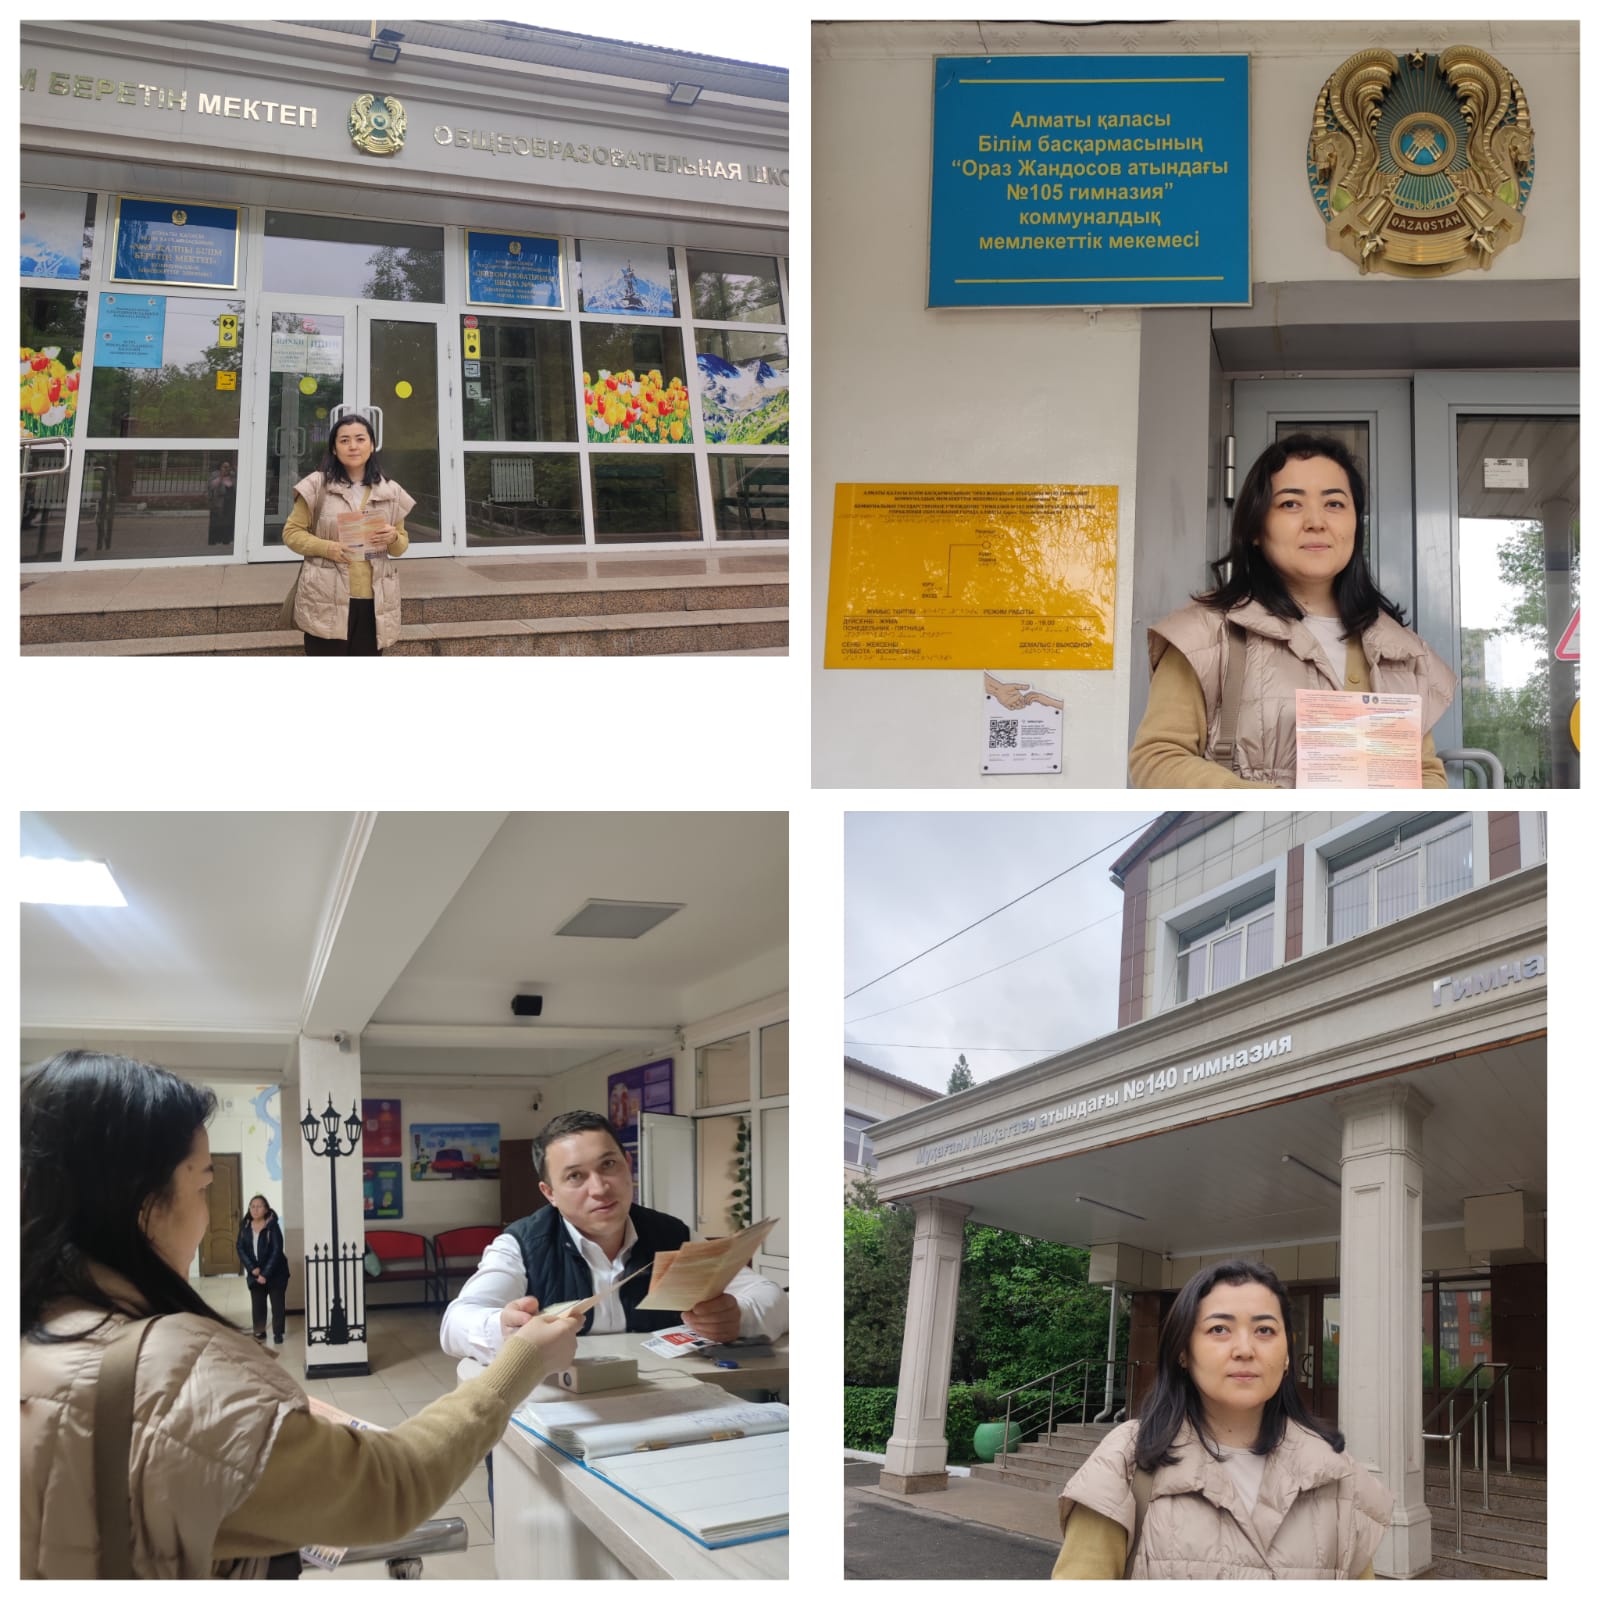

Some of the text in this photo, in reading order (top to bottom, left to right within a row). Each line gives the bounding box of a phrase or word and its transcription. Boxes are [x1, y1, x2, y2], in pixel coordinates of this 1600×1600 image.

[49, 71, 187, 112] БЕРЕТІН
[198, 92, 318, 129] МЕКТЕП
[1010, 111, 1171, 130] Алматы қаласы
[432, 125, 743, 182] ОБЩЕОБРАЗОВАТЕЛЬНАЯ
[978, 134, 1203, 156] Білім басқармасының
[952, 159, 1228, 181] “Ораз Жандосов атындағы
[1007, 182, 1174, 201] №105 гимназия”
[1019, 209, 1161, 228] коммуналдық
[1391, 213, 1462, 232] QAZAQSTAN
[979, 230, 1199, 250] мемлекеттік мекемесі
[1432, 953, 1546, 1008] Гимна
[1039, 1090, 1119, 1128] атындағы
[1123, 1067, 1178, 1103] №140
[1182, 1034, 1293, 1085] гимназия
